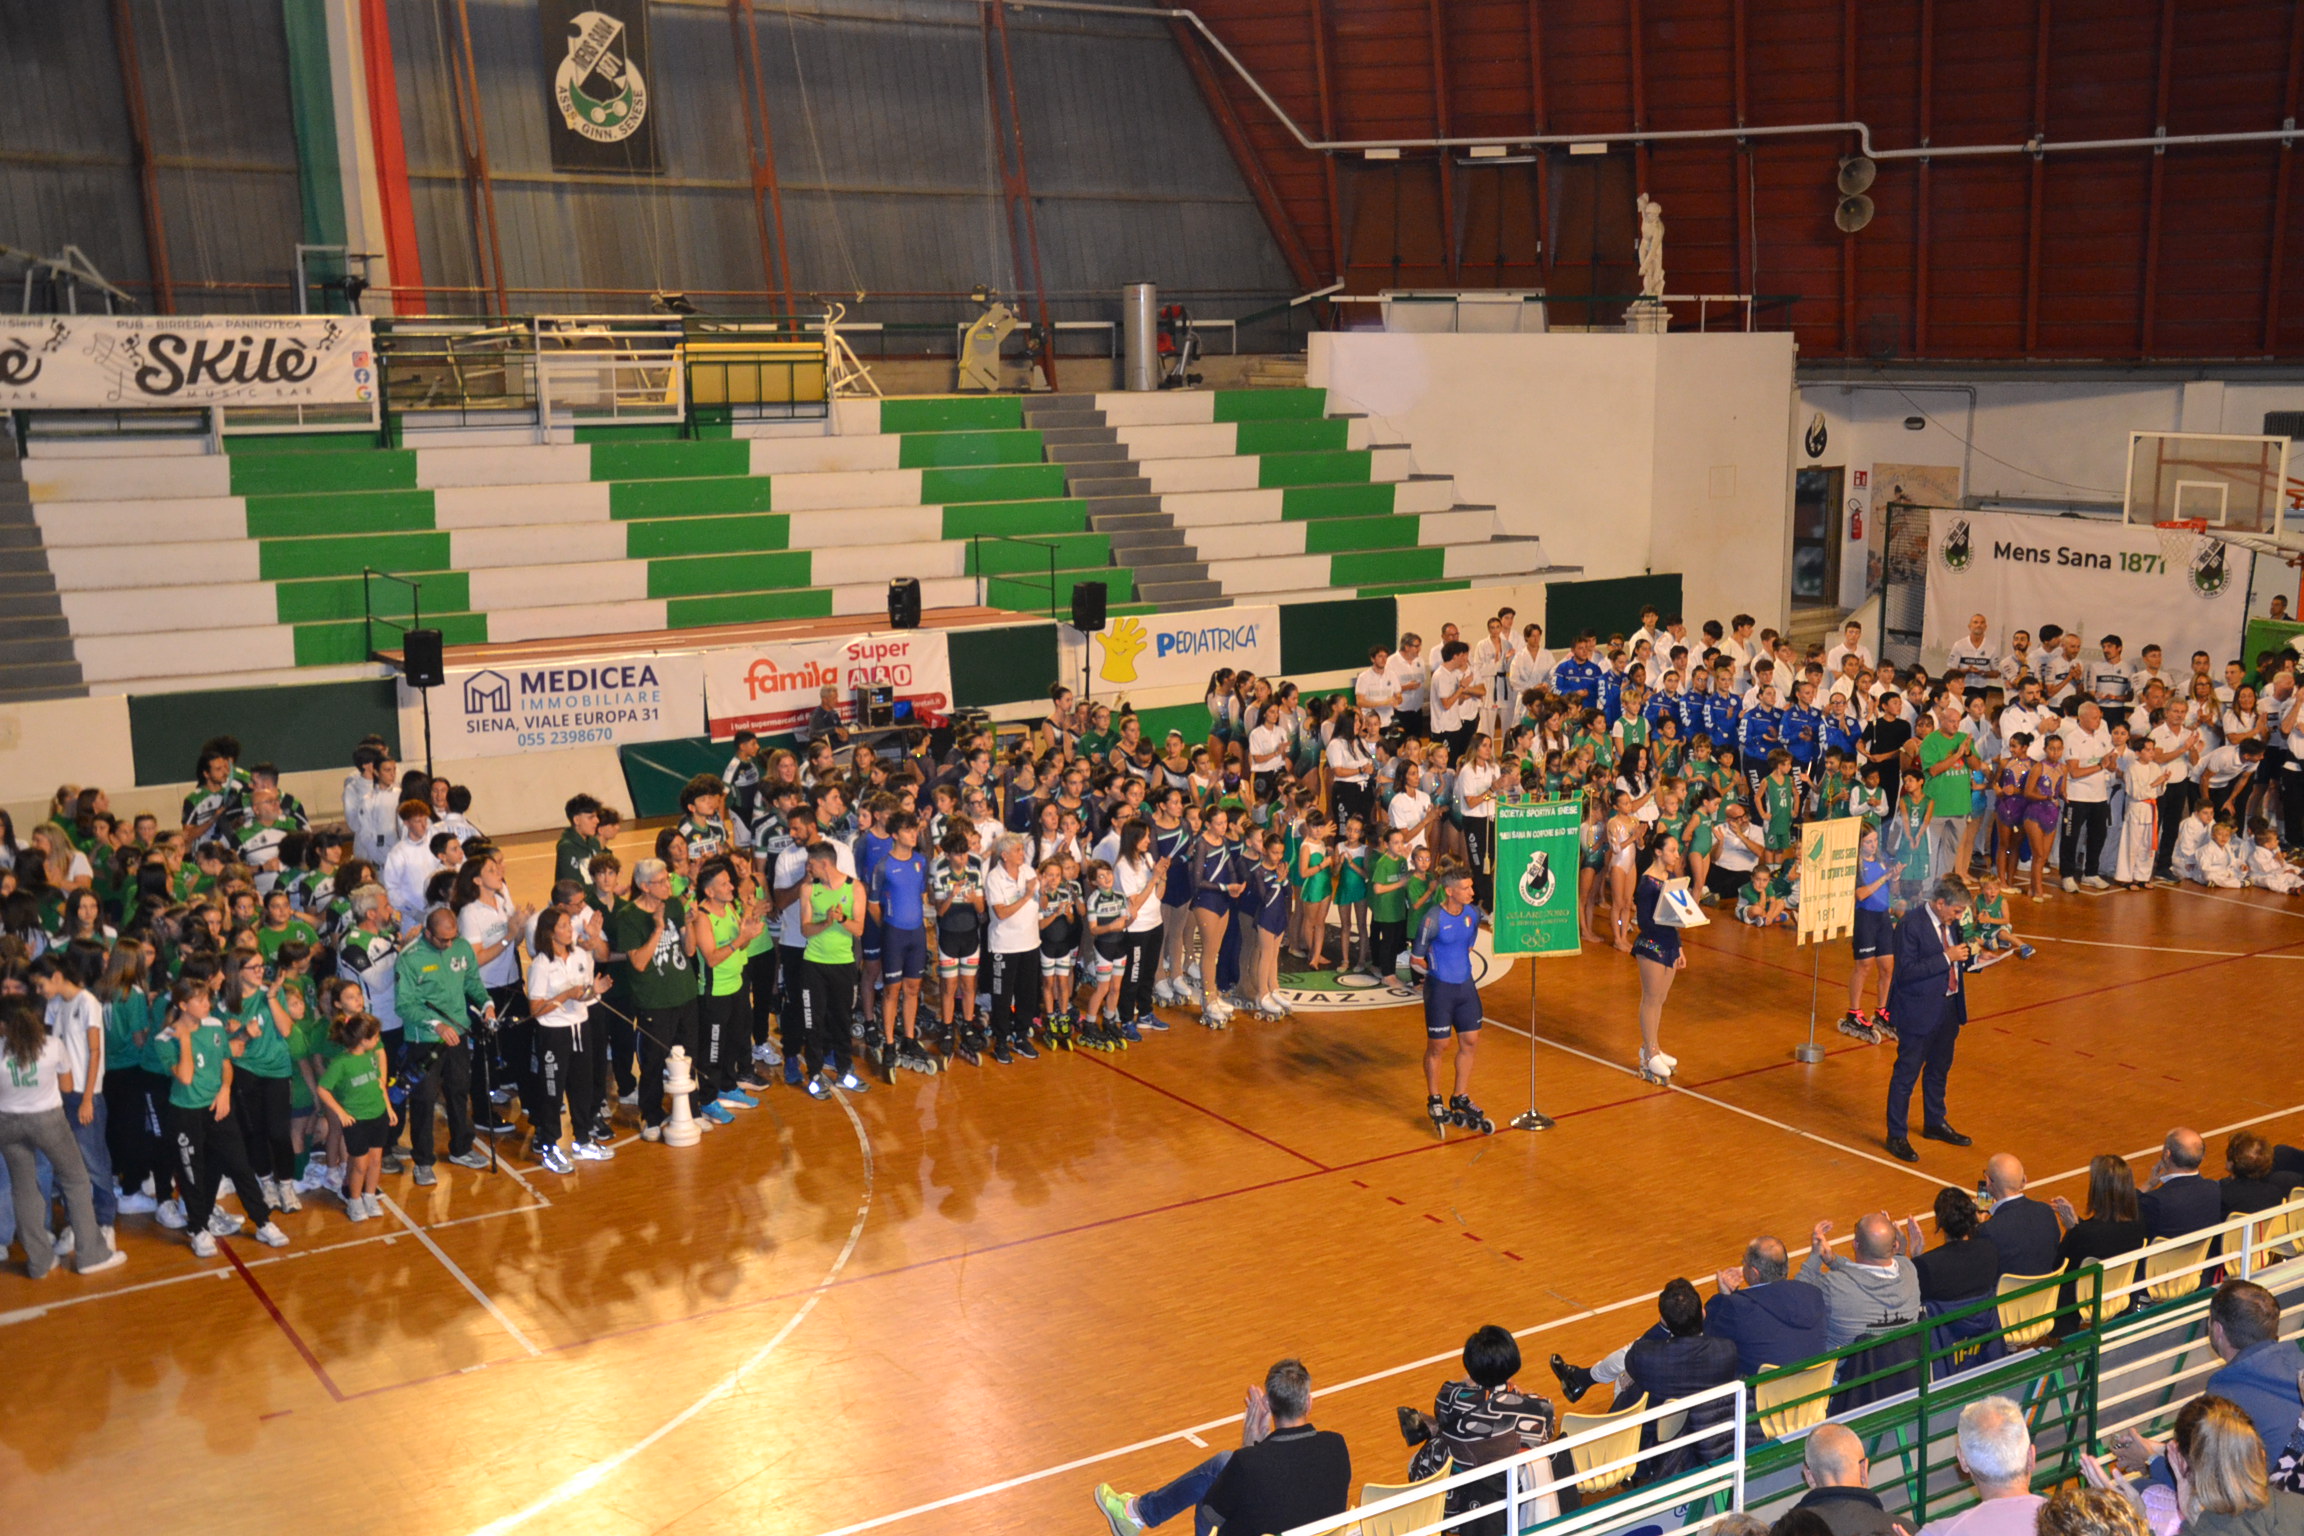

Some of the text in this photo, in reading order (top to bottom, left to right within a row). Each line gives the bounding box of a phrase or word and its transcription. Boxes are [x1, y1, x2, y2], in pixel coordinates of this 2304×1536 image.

[618, 90, 643, 135] SENESE
[116, 320, 144, 329] PUB
[225, 320, 302, 329] PANINOTECA
[187, 388, 312, 398] MUSIC BAR
[1993, 541, 2051, 564] Mens
[2057, 546, 2112, 570] Sana
[847, 642, 910, 662] Super
[1156, 624, 1256, 658] PEDIATRICA
[520, 665, 659, 695] MEDICEA
[743, 658, 838, 701] famila
[520, 690, 661, 711] IMMOBILIARE
[466, 708, 659, 734] SIENA, VIALE EUROPA 31
[517, 728, 613, 747] 055 2398670
[196, 1053, 205, 1067] 3
